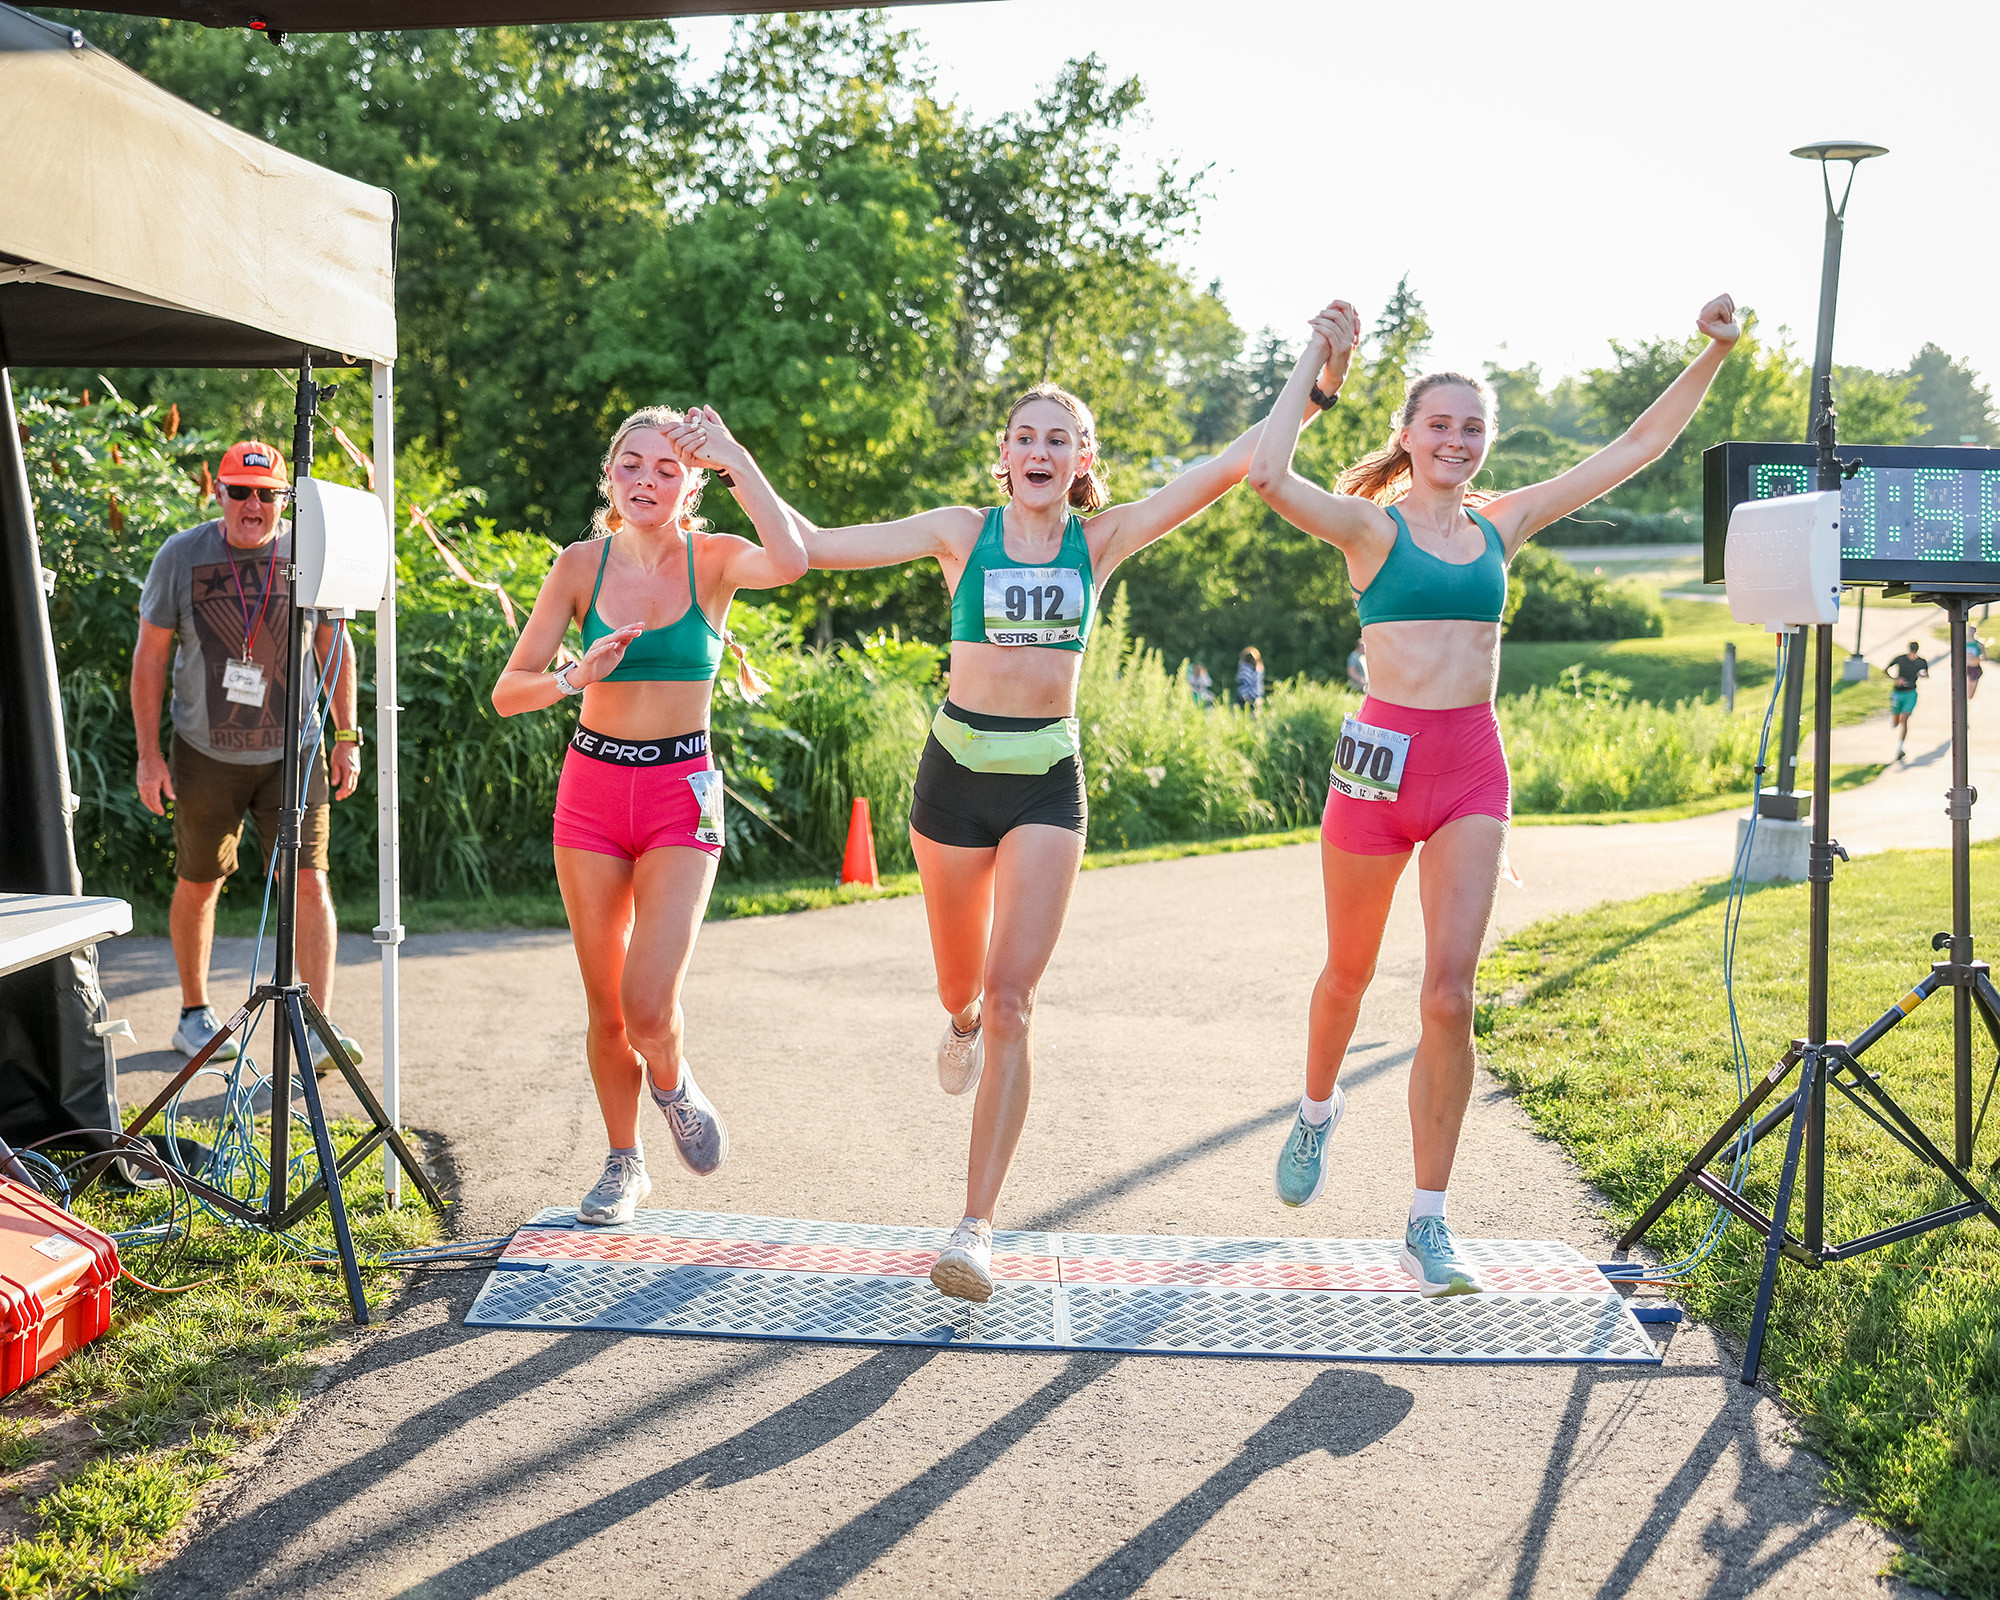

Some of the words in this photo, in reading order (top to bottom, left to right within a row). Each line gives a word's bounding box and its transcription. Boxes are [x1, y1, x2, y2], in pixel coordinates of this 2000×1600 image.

[1005, 585, 1064, 622] 912
[214, 730, 255, 749] RISE
[598, 741, 661, 762] PRO
